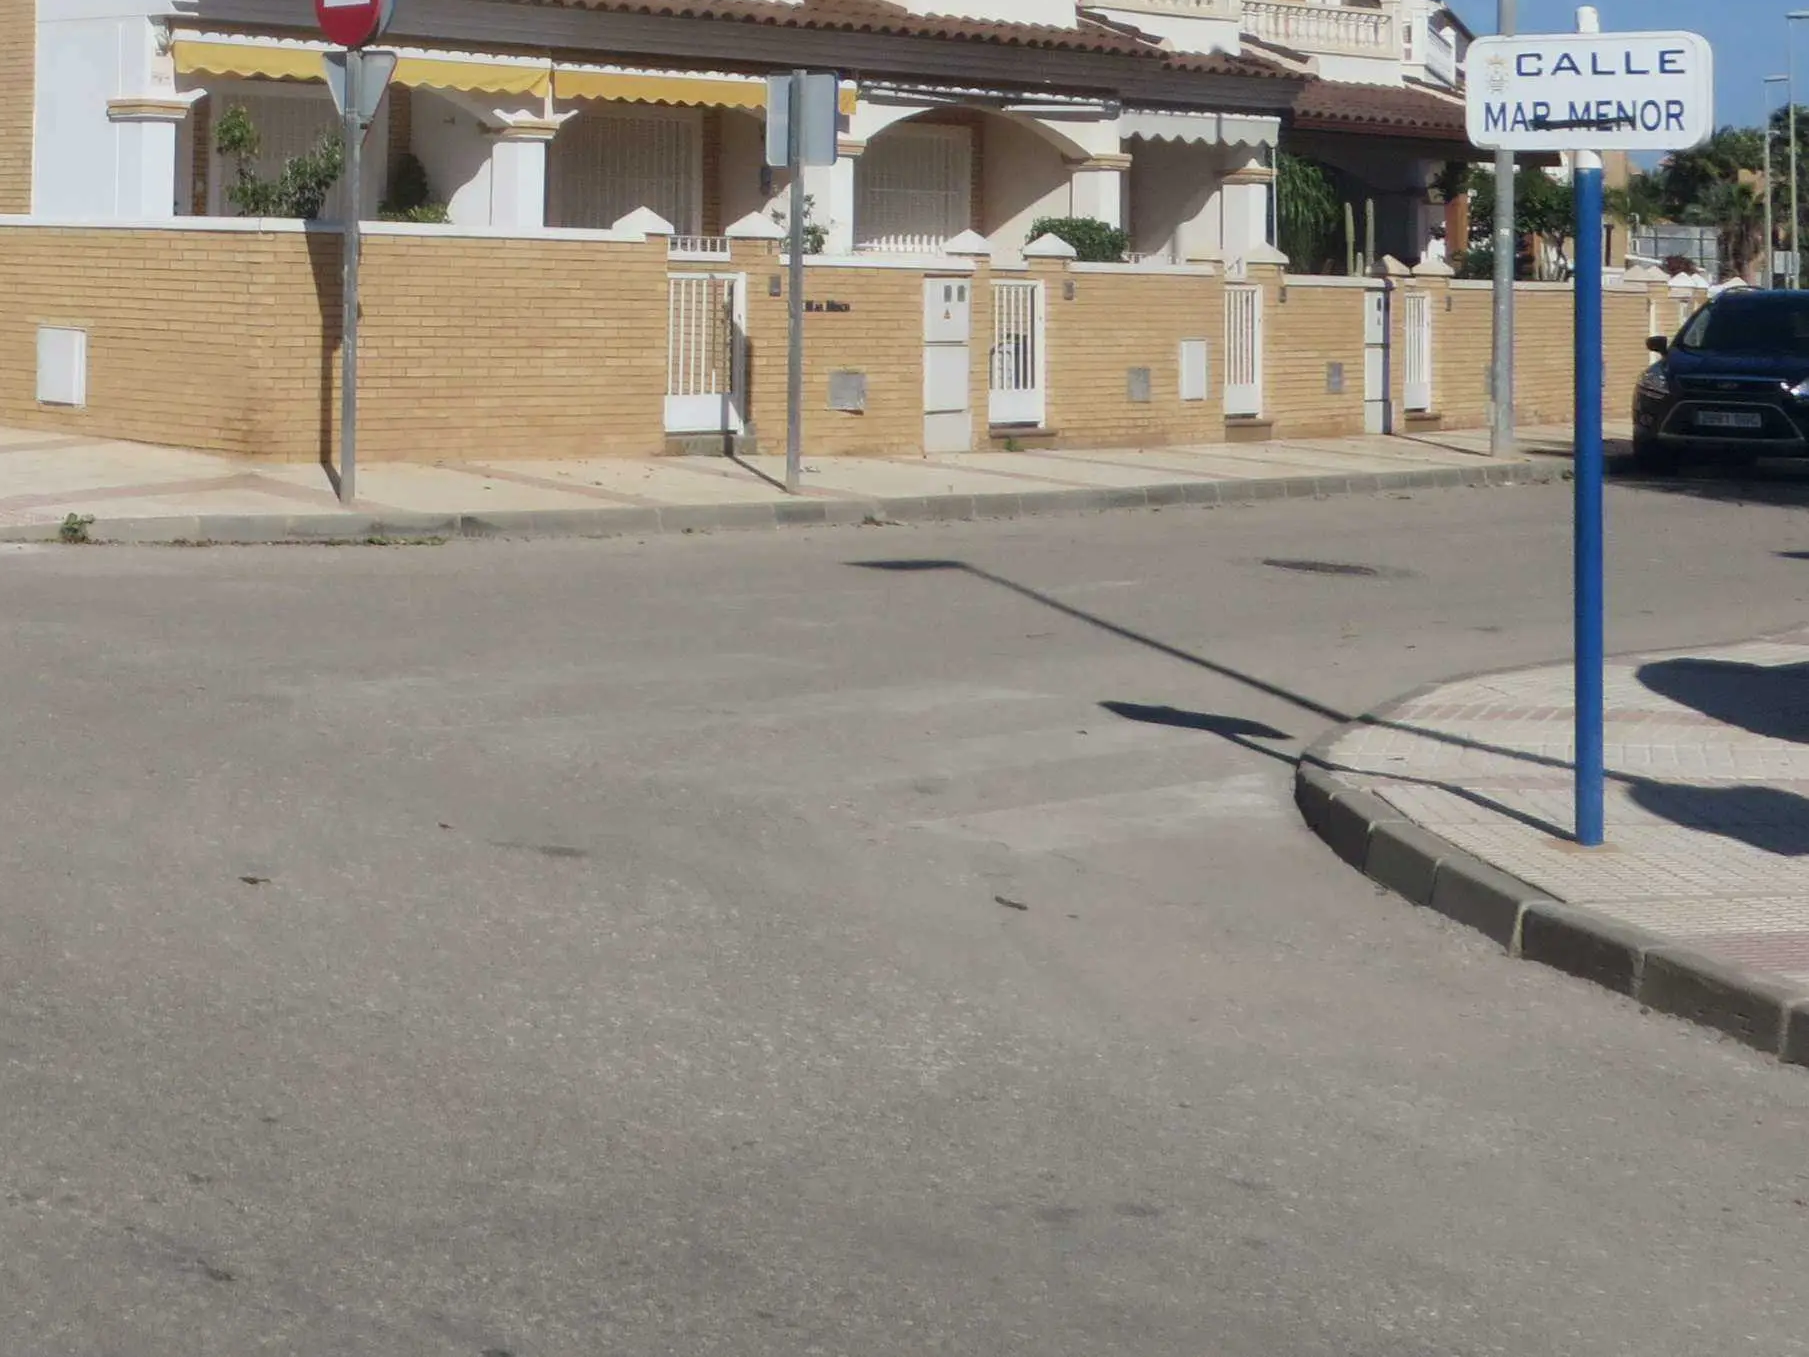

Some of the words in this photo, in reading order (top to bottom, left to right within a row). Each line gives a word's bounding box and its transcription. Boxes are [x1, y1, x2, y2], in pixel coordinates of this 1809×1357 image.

[1515, 49, 1686, 77] CALLE
[1484, 100, 1551, 132] MAR
[1568, 99, 1685, 132] MENOR
